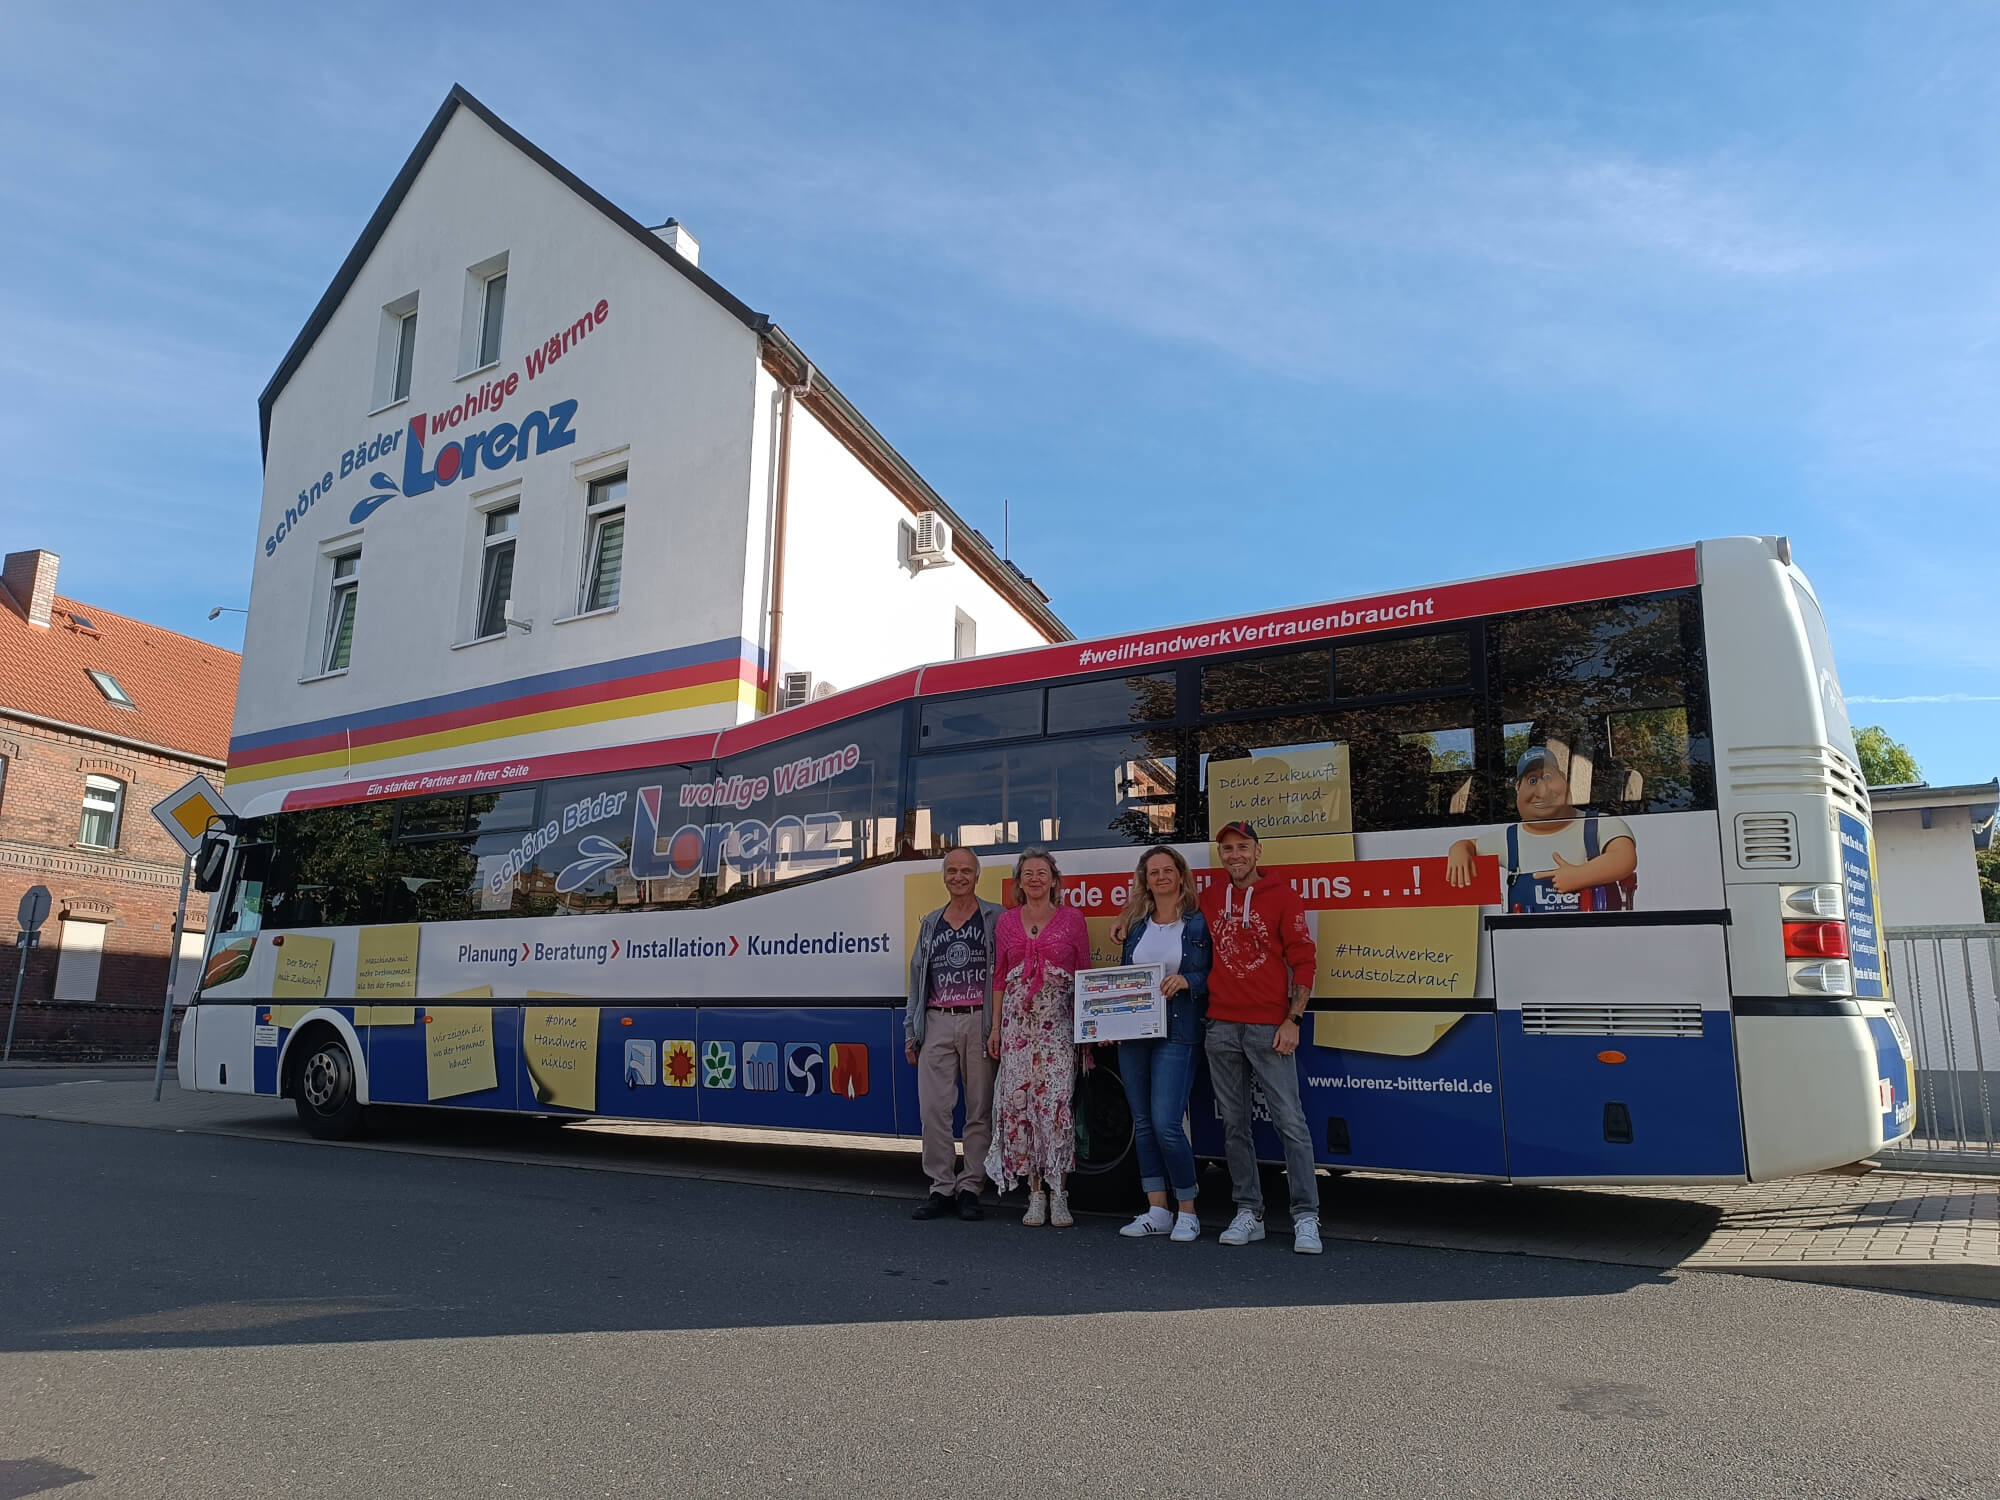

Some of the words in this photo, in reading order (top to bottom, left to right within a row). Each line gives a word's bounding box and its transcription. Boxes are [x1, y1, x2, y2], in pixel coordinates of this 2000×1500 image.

[432, 371, 518, 435] wohlige
[526, 299, 609, 380] Wärme
[402, 398, 578, 498] Lorenz
[265, 471, 334, 558] schöne
[340, 428, 403, 480] Bäder
[1079, 597, 1434, 666] #weilHandwerkVertrauenbraucht
[366, 784, 382, 796] Ein
[384, 780, 418, 794] starker
[420, 774, 458, 789] Partner
[458, 773, 472, 784] an
[474, 769, 500, 782] Ihrer
[502, 764, 530, 778] Seite
[680, 771, 768, 810] wohlige
[774, 744, 860, 796] Wärme
[1219, 773, 1260, 789] Deine
[1264, 762, 1338, 784] Zukunft
[1230, 796, 1246, 808] in
[1251, 794, 1274, 807] der
[1279, 787, 1328, 803] Hand-
[490, 820, 560, 895] schöne
[562, 790, 628, 834] Bäder
[629, 784, 842, 881] Lorenz
[1060, 881, 1103, 908] rde
[458, 944, 518, 967] Planung
[534, 941, 608, 966] Beratung
[626, 936, 726, 960] Installation
[748, 932, 890, 957] Kundendienst
[1335, 942, 1454, 964] #Handwerker
[298, 960, 318, 972] Beruf
[290, 974, 322, 989] Zukunft
[938, 968, 986, 988] PACIFIC
[1330, 967, 1459, 992] undstolzdrauf
[545, 1014, 577, 1028] #ohne
[432, 1031, 447, 1043] Wir
[448, 1027, 471, 1041] zeigen
[534, 1034, 588, 1050] Handwerk
[433, 1049, 443, 1058] wo
[443, 1045, 455, 1055] der
[455, 1039, 486, 1051] Hammer
[449, 1057, 472, 1070] hängt!
[541, 1054, 576, 1070] nixlos!
[1308, 1074, 1493, 1094] www.lorenz-bitterfeld.de
